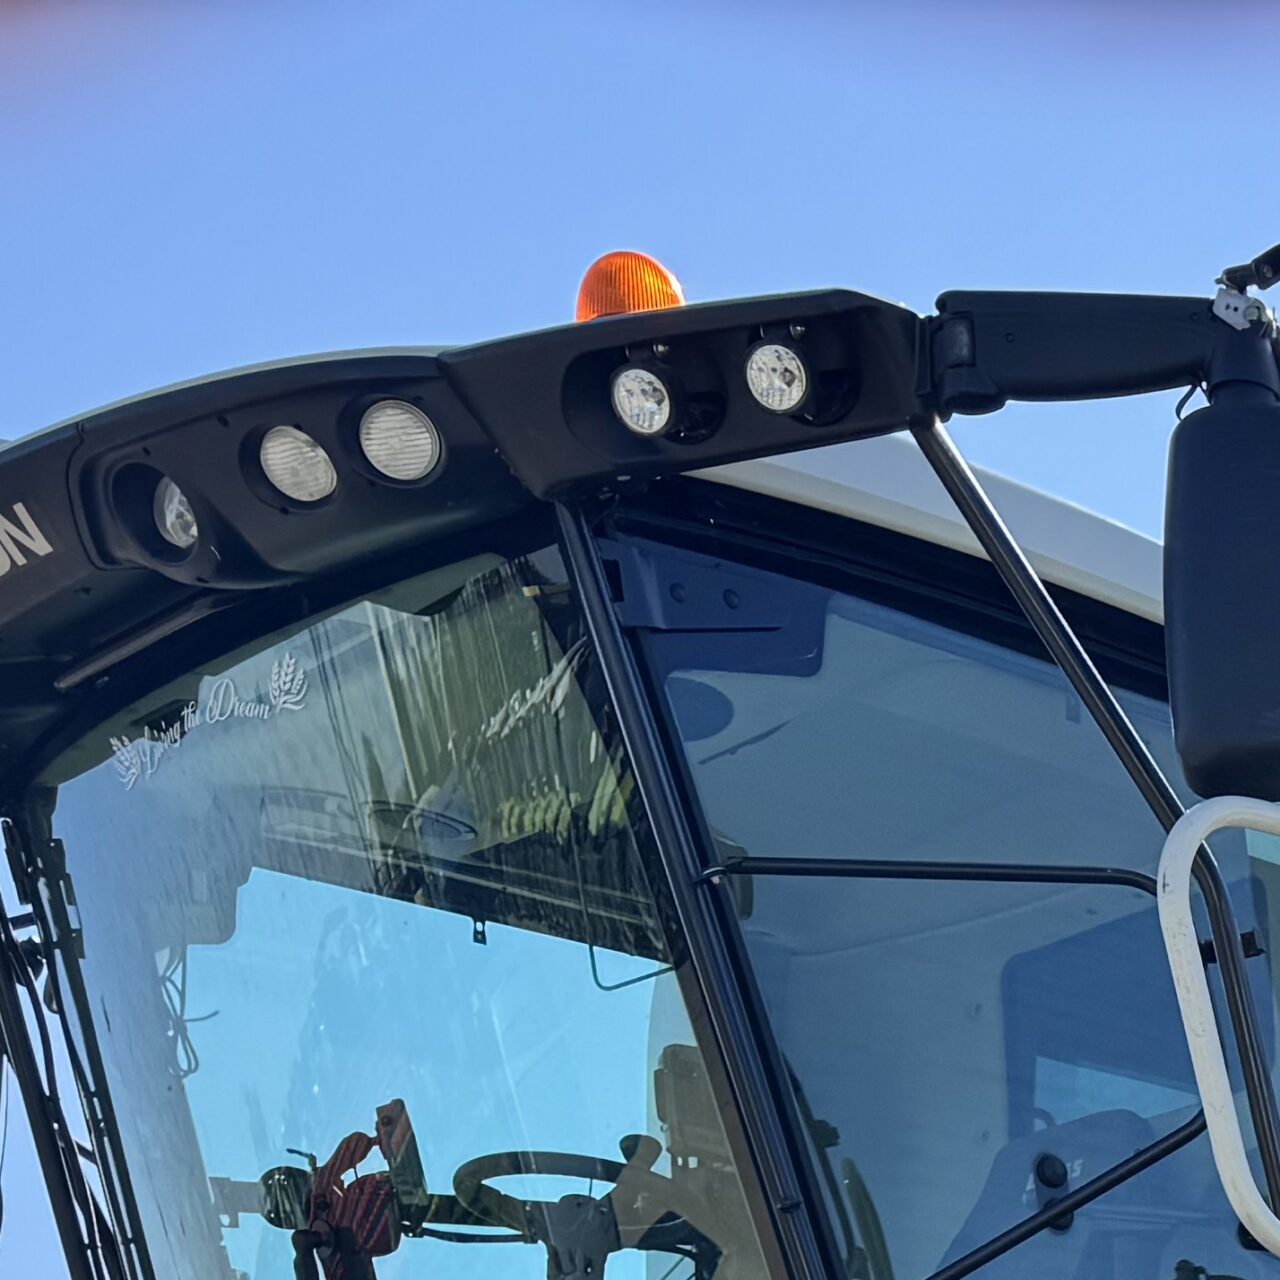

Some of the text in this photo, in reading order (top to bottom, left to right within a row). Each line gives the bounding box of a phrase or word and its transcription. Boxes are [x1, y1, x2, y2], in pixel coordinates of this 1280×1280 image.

[0, 502, 54, 577] N
[181, 700, 200, 733] the
[206, 678, 270, 724] Dream
